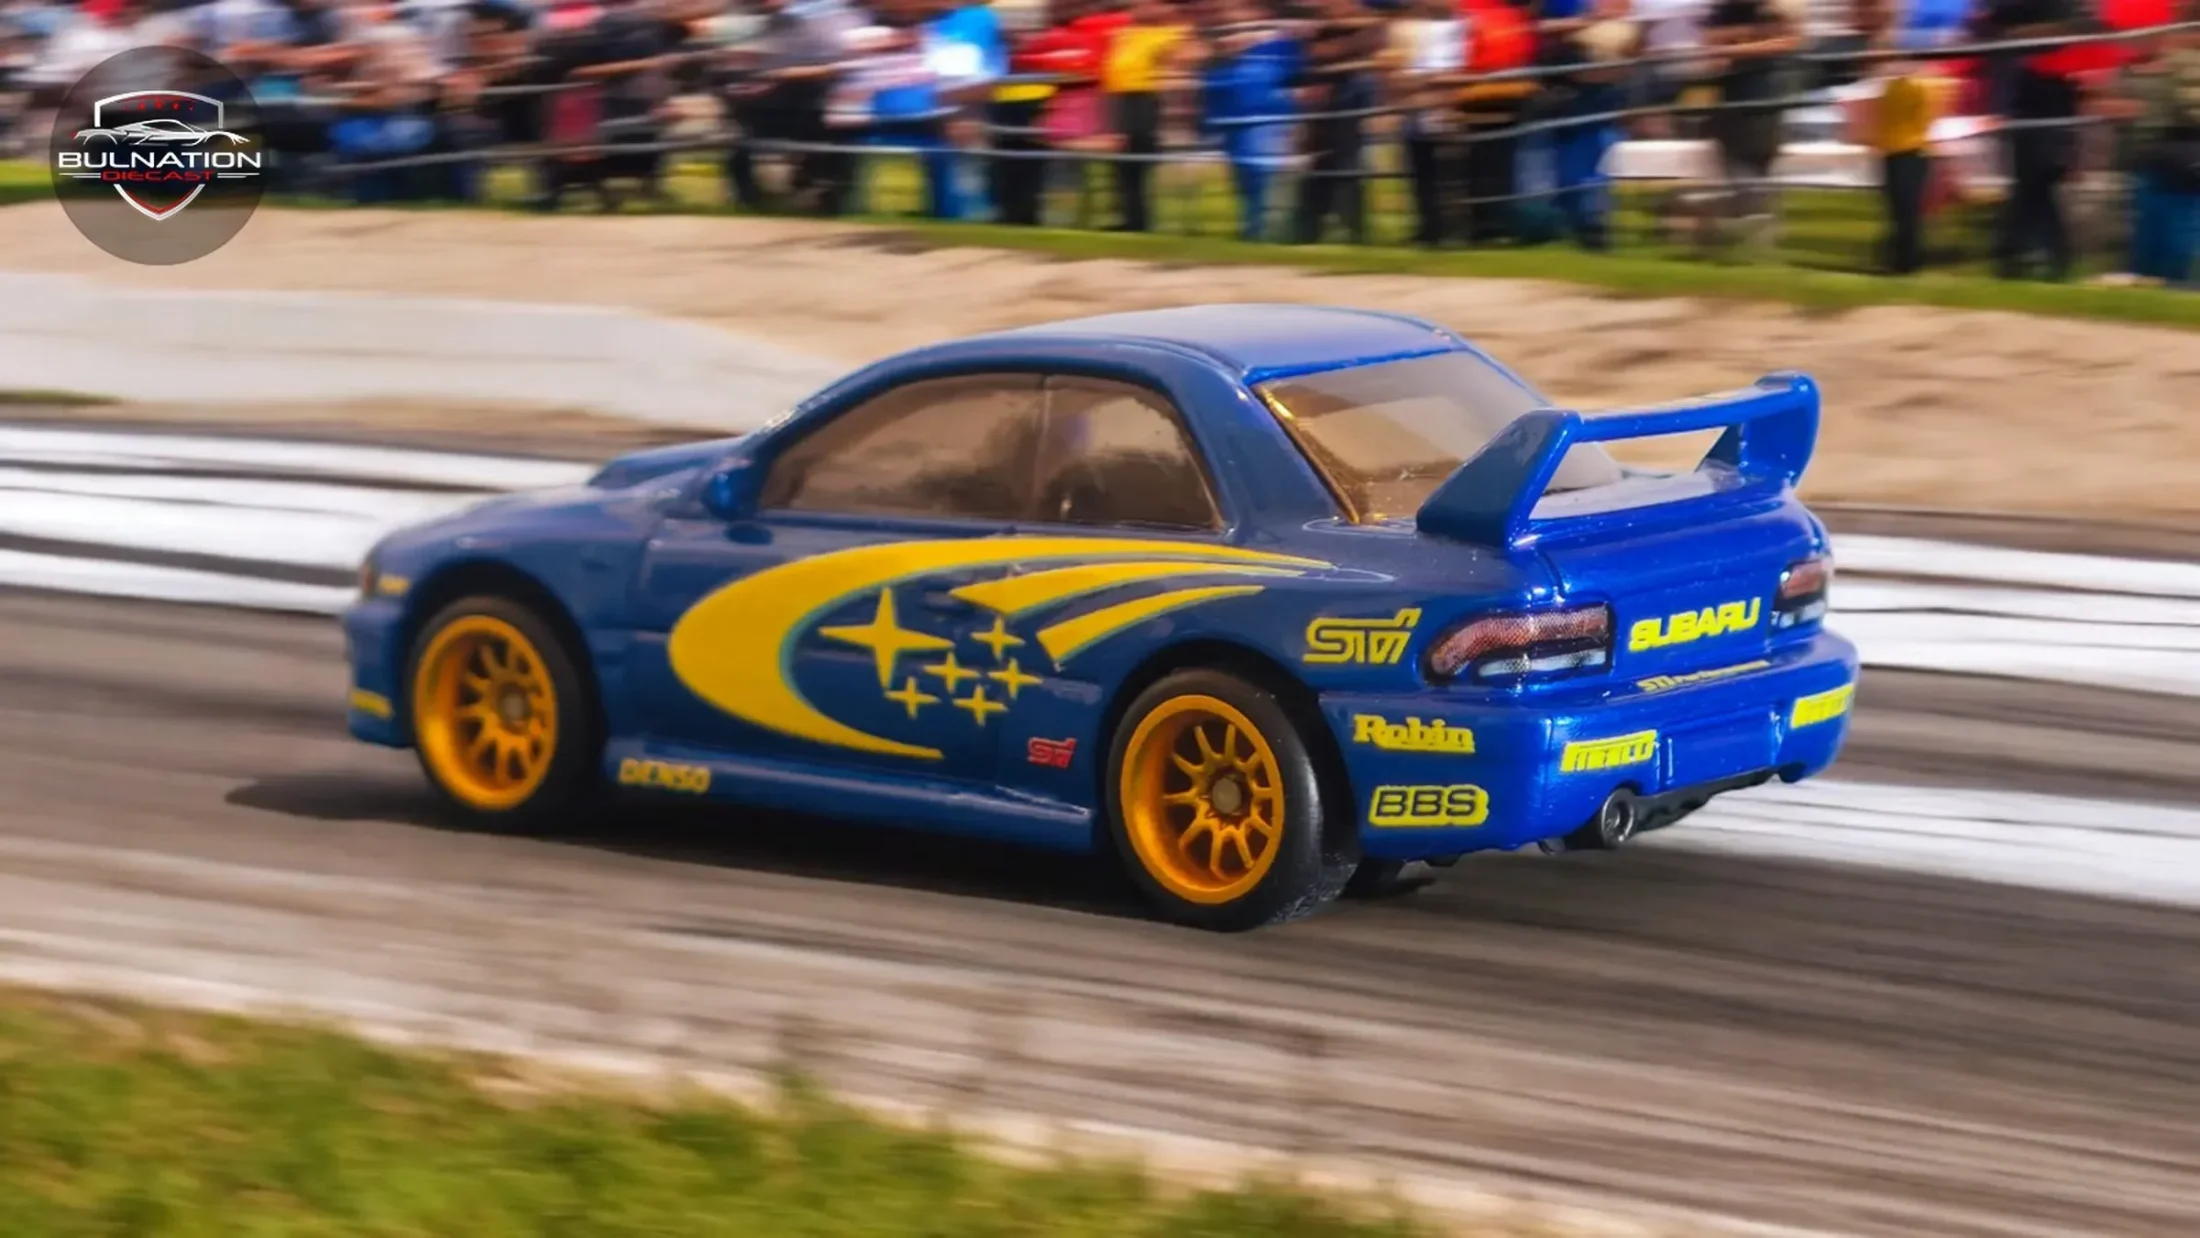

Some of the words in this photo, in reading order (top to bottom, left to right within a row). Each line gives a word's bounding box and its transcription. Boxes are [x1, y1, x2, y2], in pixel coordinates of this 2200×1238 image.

[1628, 596, 1761, 652] SUBARU
[1353, 714, 1475, 753] Robin
[1374, 788, 1479, 818] BBS
